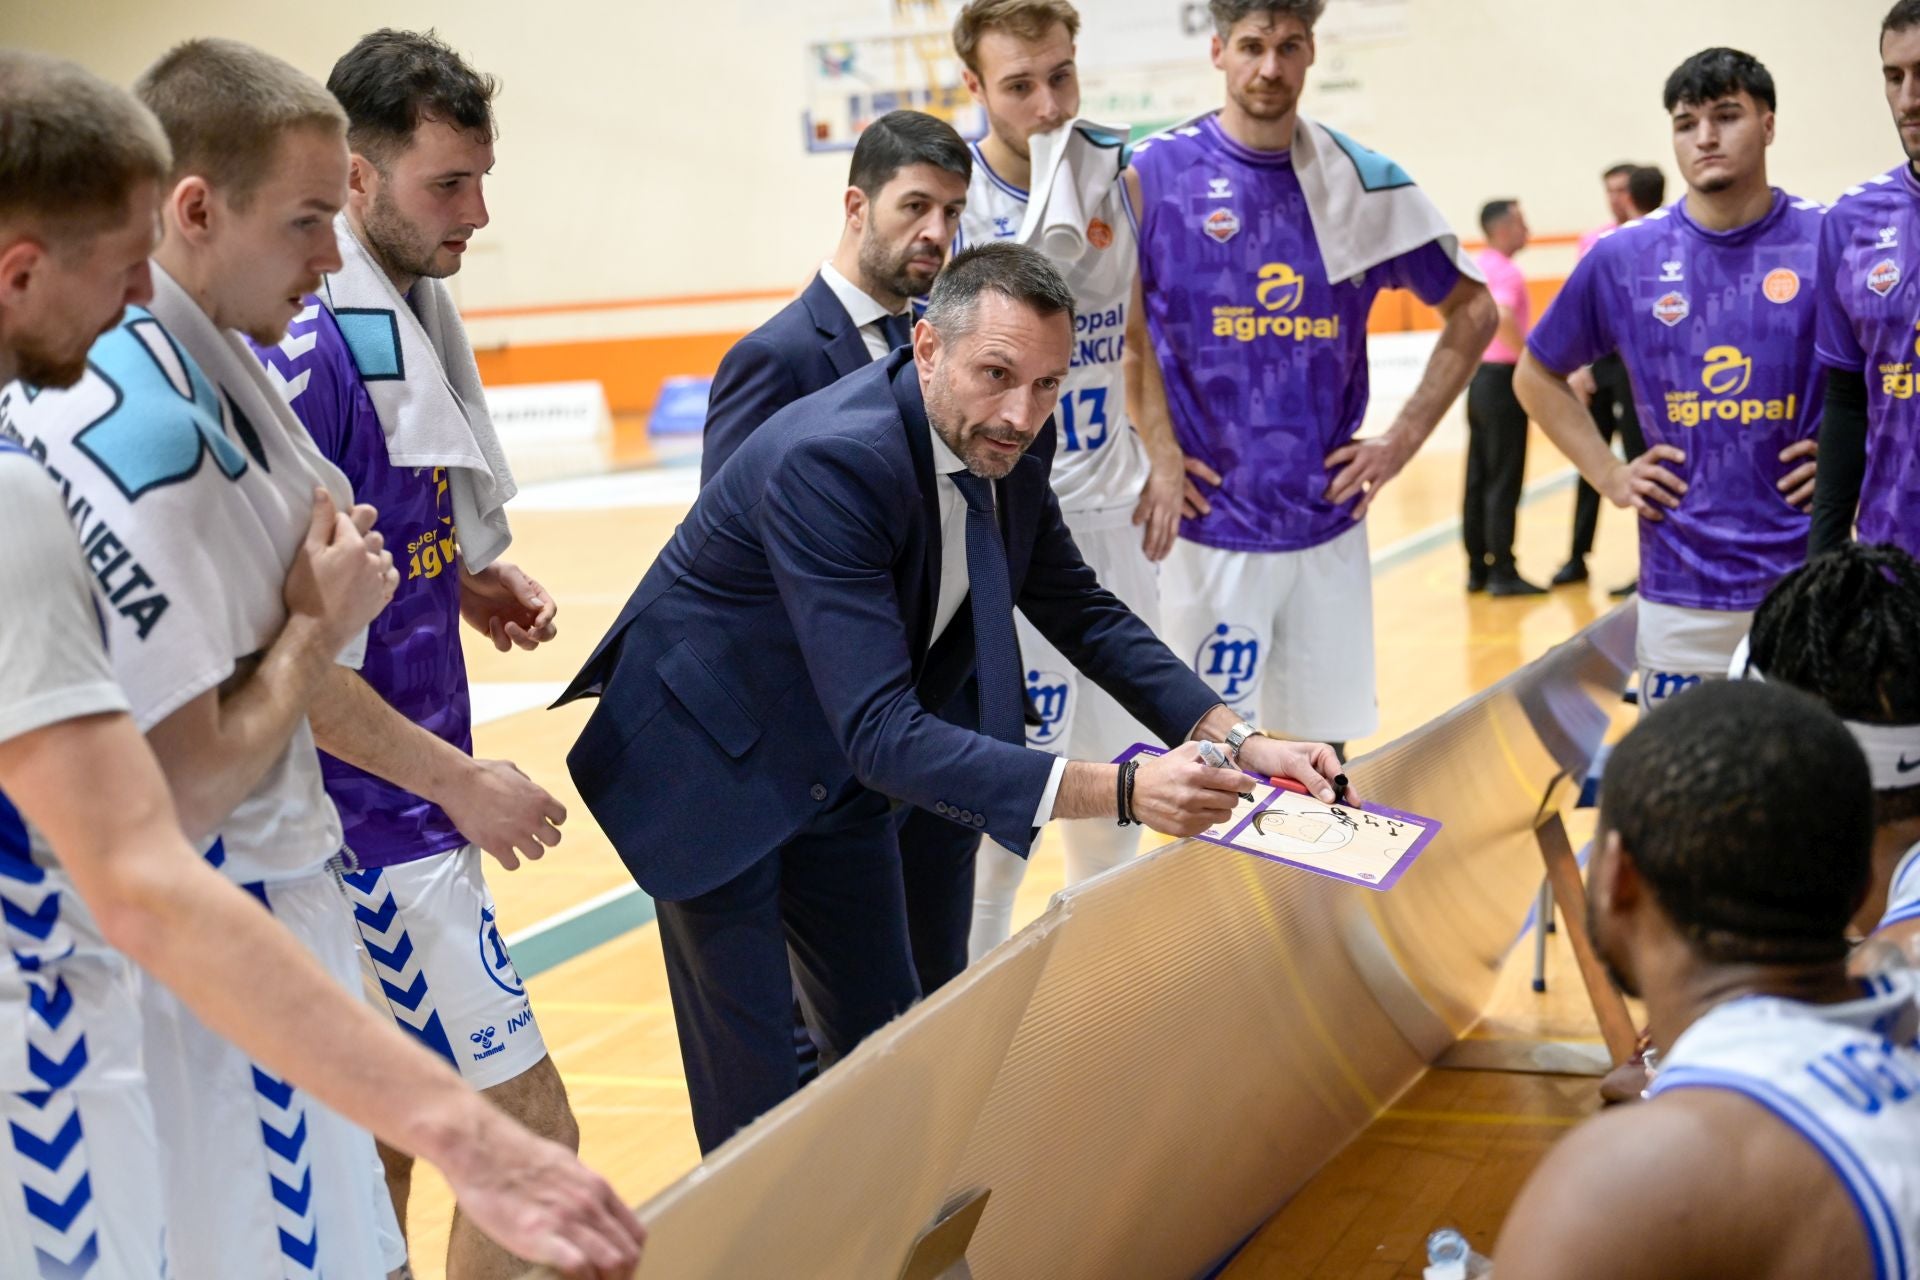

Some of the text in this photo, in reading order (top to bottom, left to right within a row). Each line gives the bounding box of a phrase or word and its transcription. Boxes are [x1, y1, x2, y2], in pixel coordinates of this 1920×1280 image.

[1075, 303, 1123, 334] opal
[1212, 314, 1339, 342] agropal
[1059, 387, 1108, 452] 13
[1667, 393, 1796, 427] agropal
[473, 1042, 506, 1061] hummel
